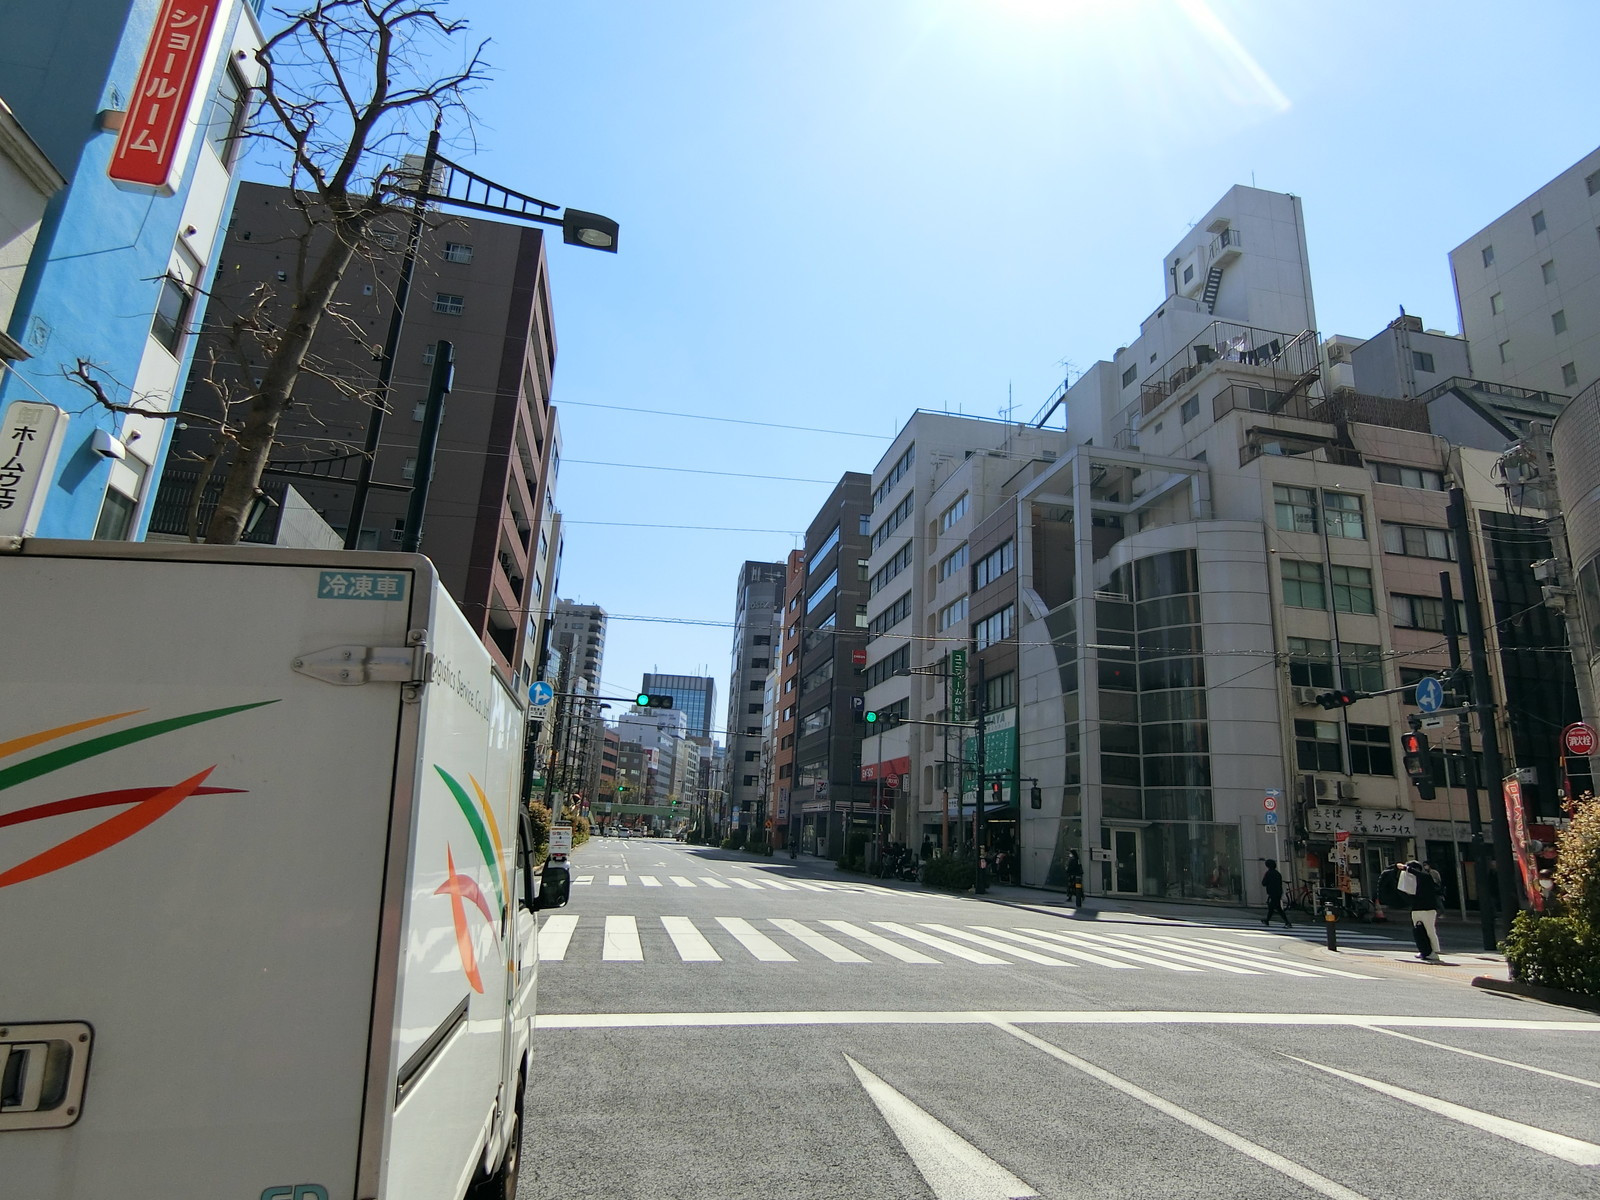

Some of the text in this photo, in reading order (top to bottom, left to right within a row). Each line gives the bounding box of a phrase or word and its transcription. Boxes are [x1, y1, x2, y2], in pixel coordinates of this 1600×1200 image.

[130, 9, 198, 153] ショールーム
[321, 574, 400, 598] 冷凍車
[433, 653, 456, 690] ogistics
[853, 697, 863, 708] P
[1568, 735, 1592, 747] 消火栓
[1313, 809, 1342, 818] 生そば
[1375, 811, 1405, 821] ラーメン
[1314, 820, 1343, 831] うどん
[1372, 824, 1411, 835] カレーライス
